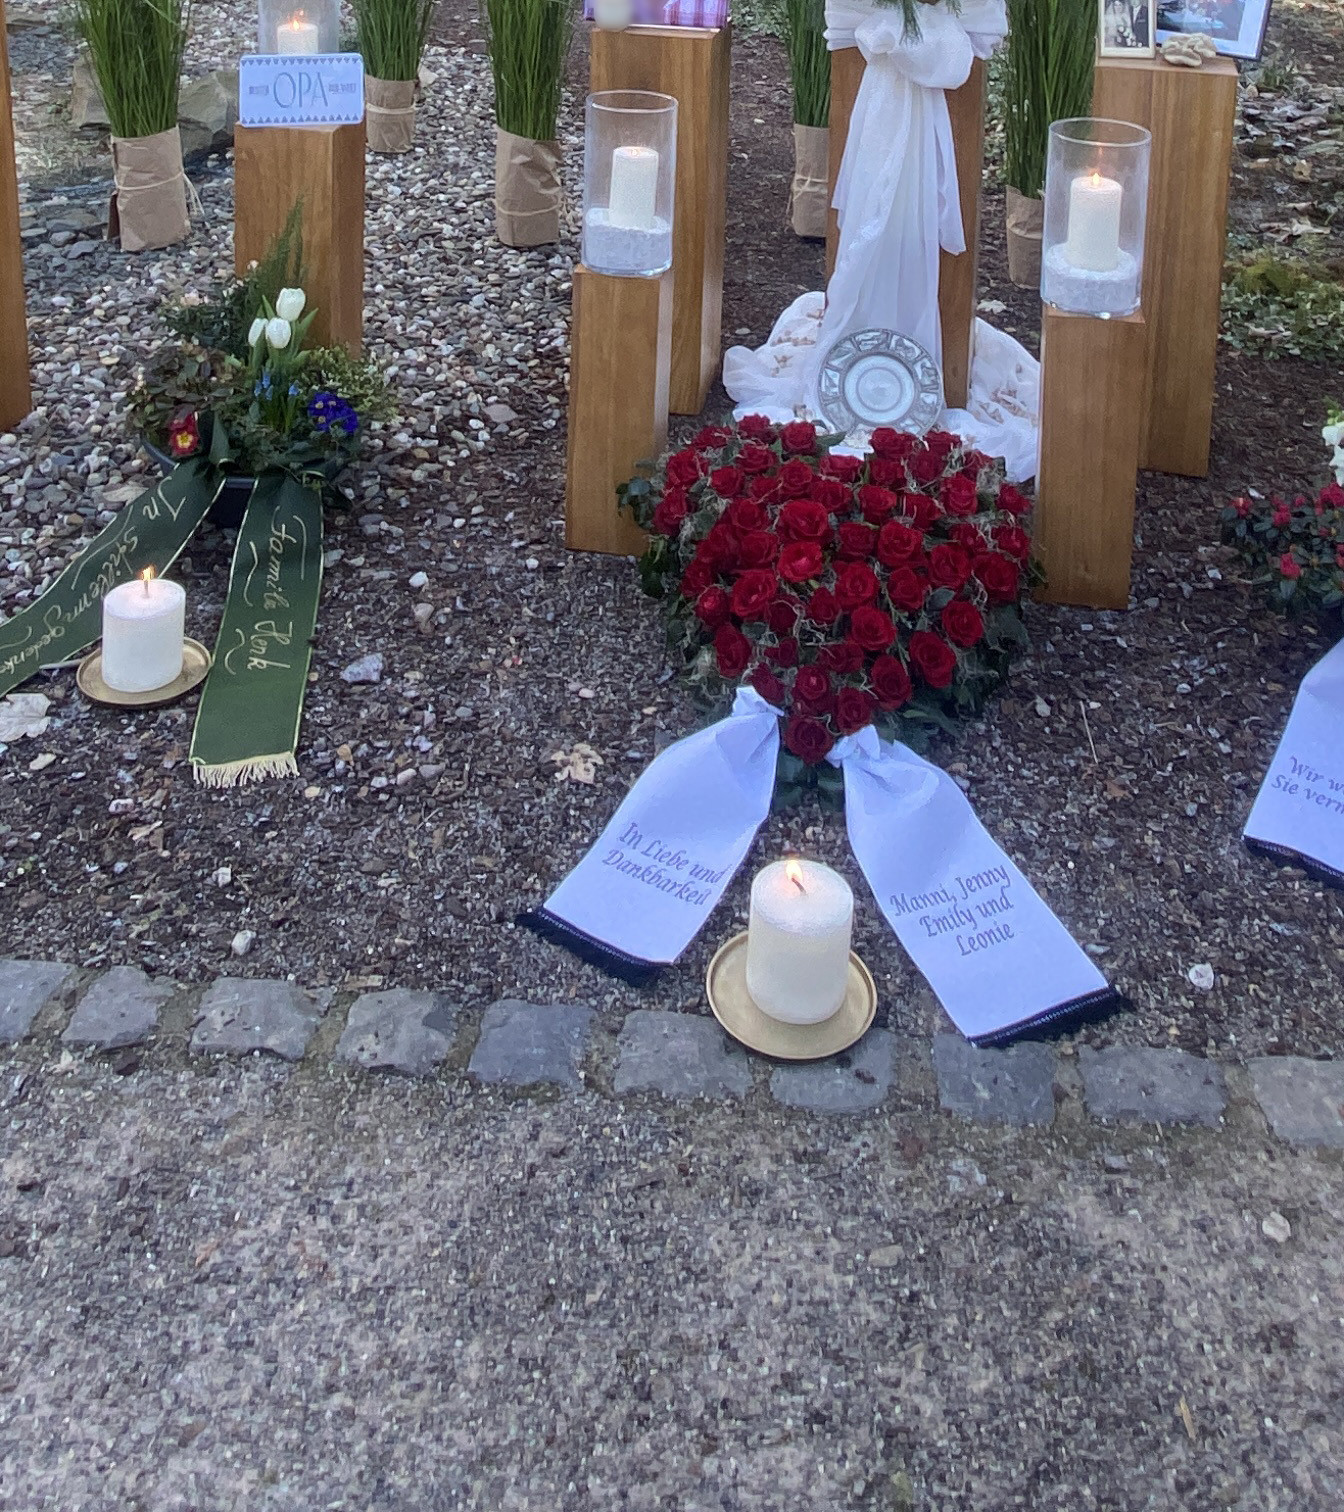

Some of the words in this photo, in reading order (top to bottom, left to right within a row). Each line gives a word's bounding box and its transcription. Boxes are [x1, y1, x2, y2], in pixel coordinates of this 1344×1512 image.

[273, 72, 329, 108] OPA
[1271, 774, 1299, 795] Sie
[1290, 755, 1325, 783] Wir
[619, 822, 644, 850] In
[640, 839, 690, 871] Liebe
[688, 863, 733, 884] und
[601, 849, 712, 906] Dankbarkeit
[889, 882, 958, 916] Manni,
[955, 864, 1011, 900] Jenny
[919, 904, 978, 937] Emily
[975, 885, 1014, 918] und
[956, 920, 1015, 956] Leonie
